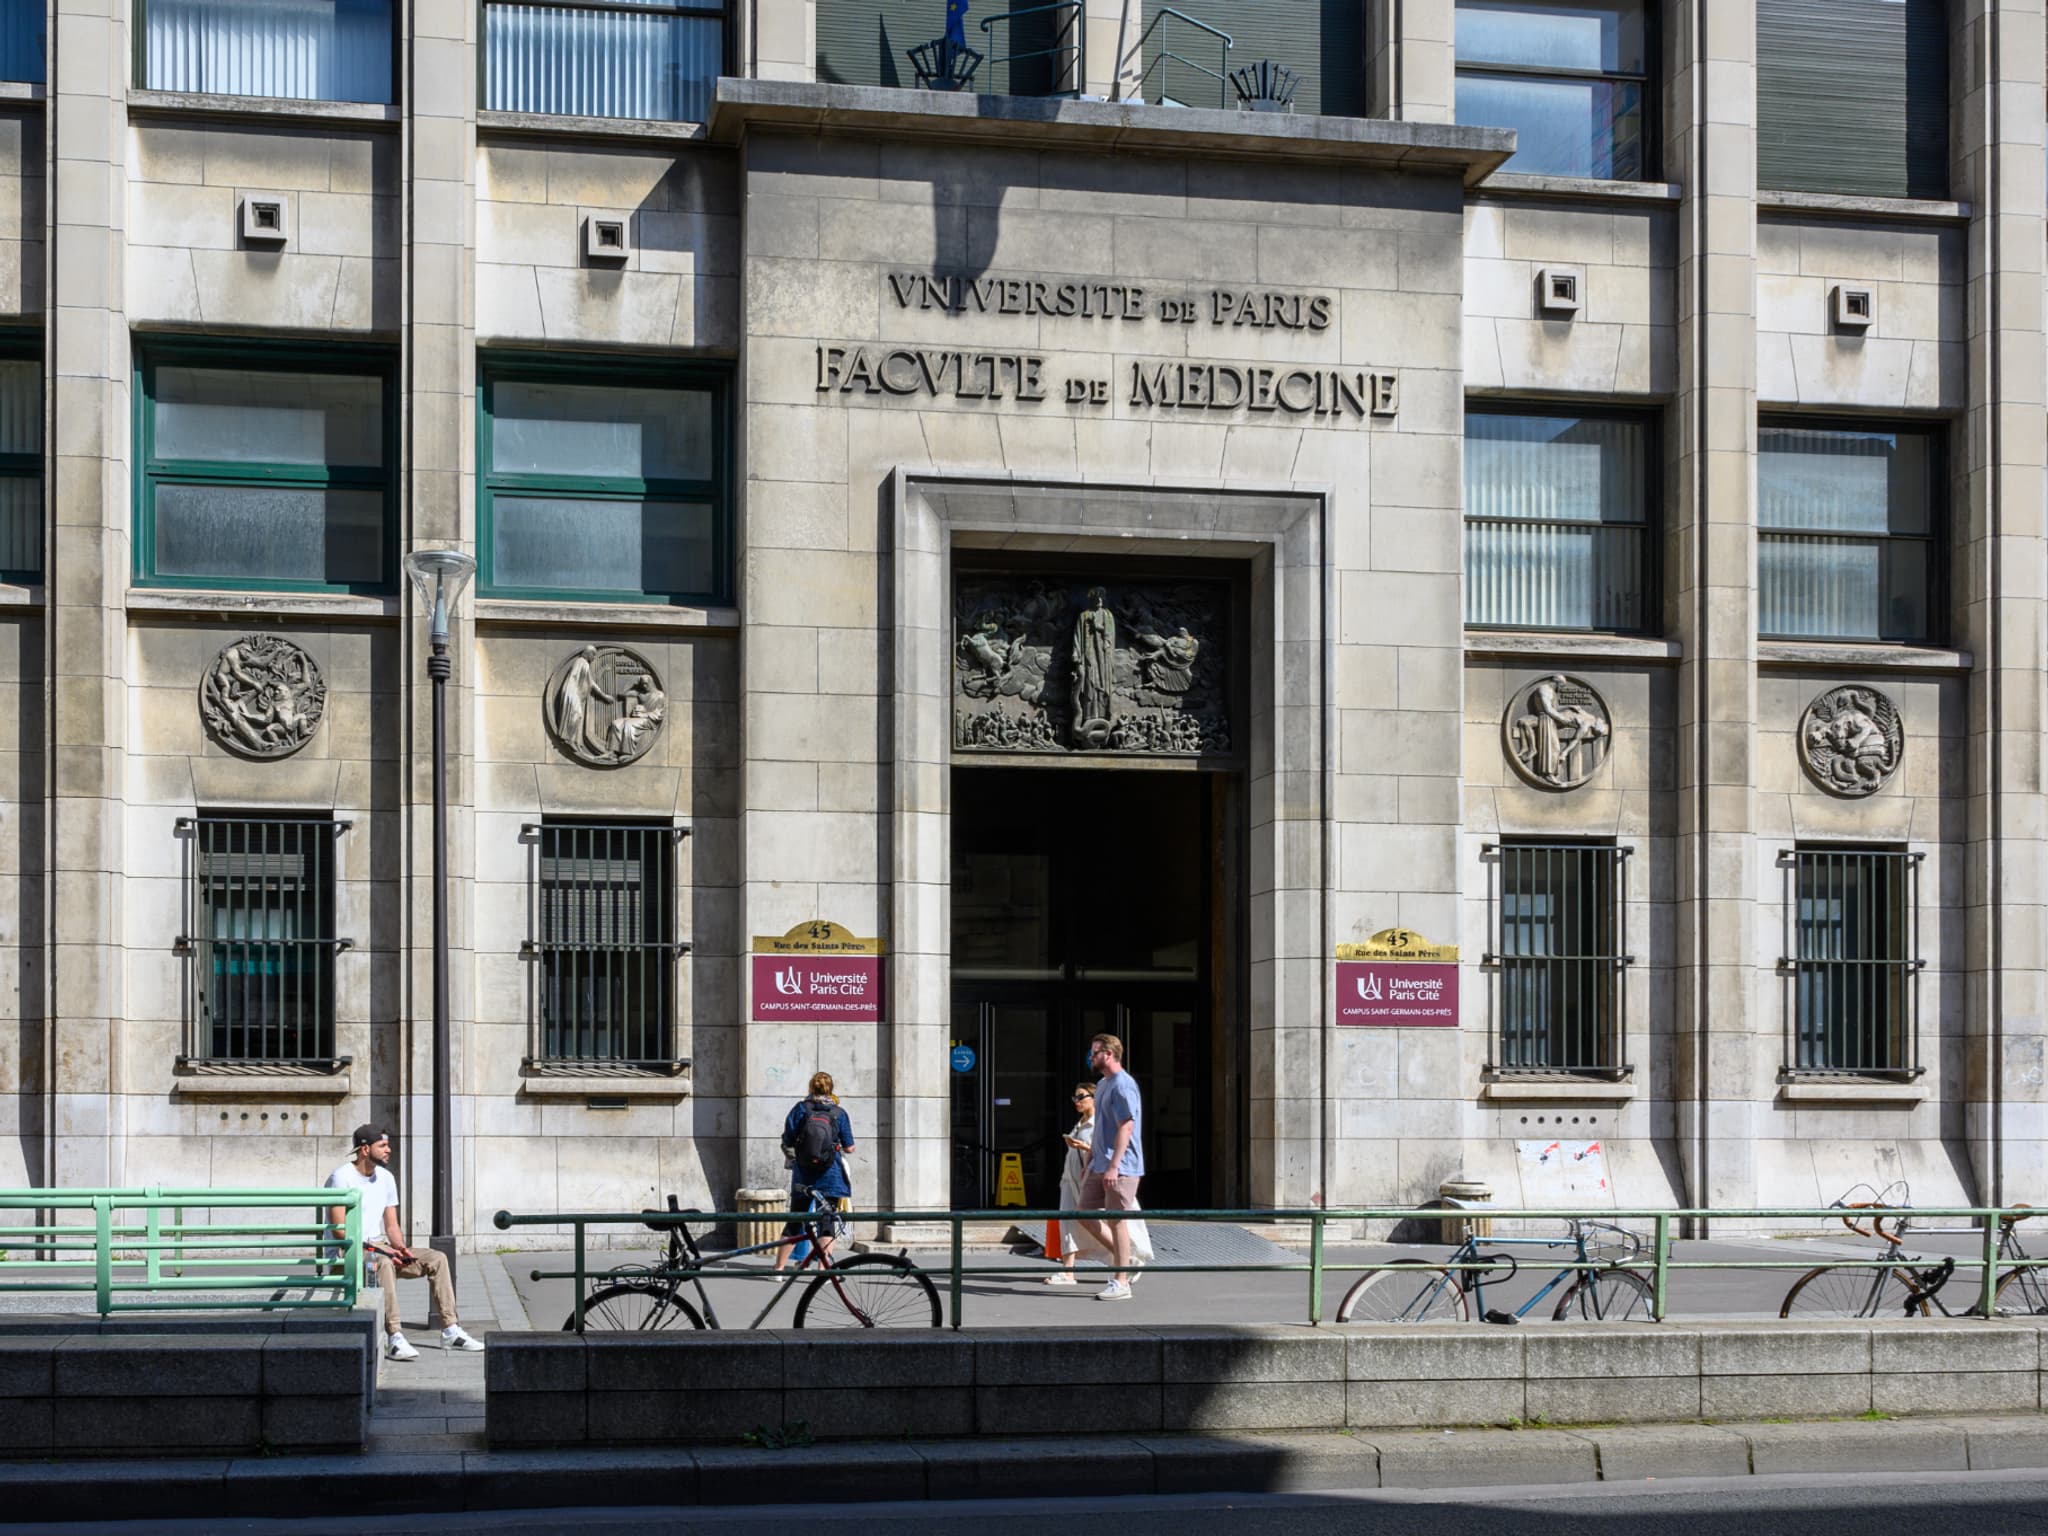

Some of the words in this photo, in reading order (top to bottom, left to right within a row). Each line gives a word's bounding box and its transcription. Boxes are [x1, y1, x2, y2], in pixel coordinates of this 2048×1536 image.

[888, 273, 1145, 321] VNIVERSITE
[1160, 301, 1196, 323] DE
[1211, 290, 1332, 330] PARIS
[816, 345, 1049, 401] FACVLTE
[1065, 378, 1110, 404] DE
[1128, 360, 1399, 418] MEDECINE
[808, 922, 831, 940] 45
[773, 941, 791, 949] Rue
[793, 941, 809, 949] des
[811, 941, 839, 950] Saints
[1386, 931, 1409, 948] 45
[1355, 949, 1371, 957] Rue
[1373, 949, 1387, 957] des
[1389, 949, 1415, 957] Saints
[1418, 950, 1440, 958] Pères
[810, 972, 868, 984] Université
[1389, 978, 1443, 990] Université
[810, 984, 837, 995] Paris
[840, 984, 864, 995] Cité
[1389, 990, 1415, 1000] Paris
[1417, 989, 1440, 1000] Cité
